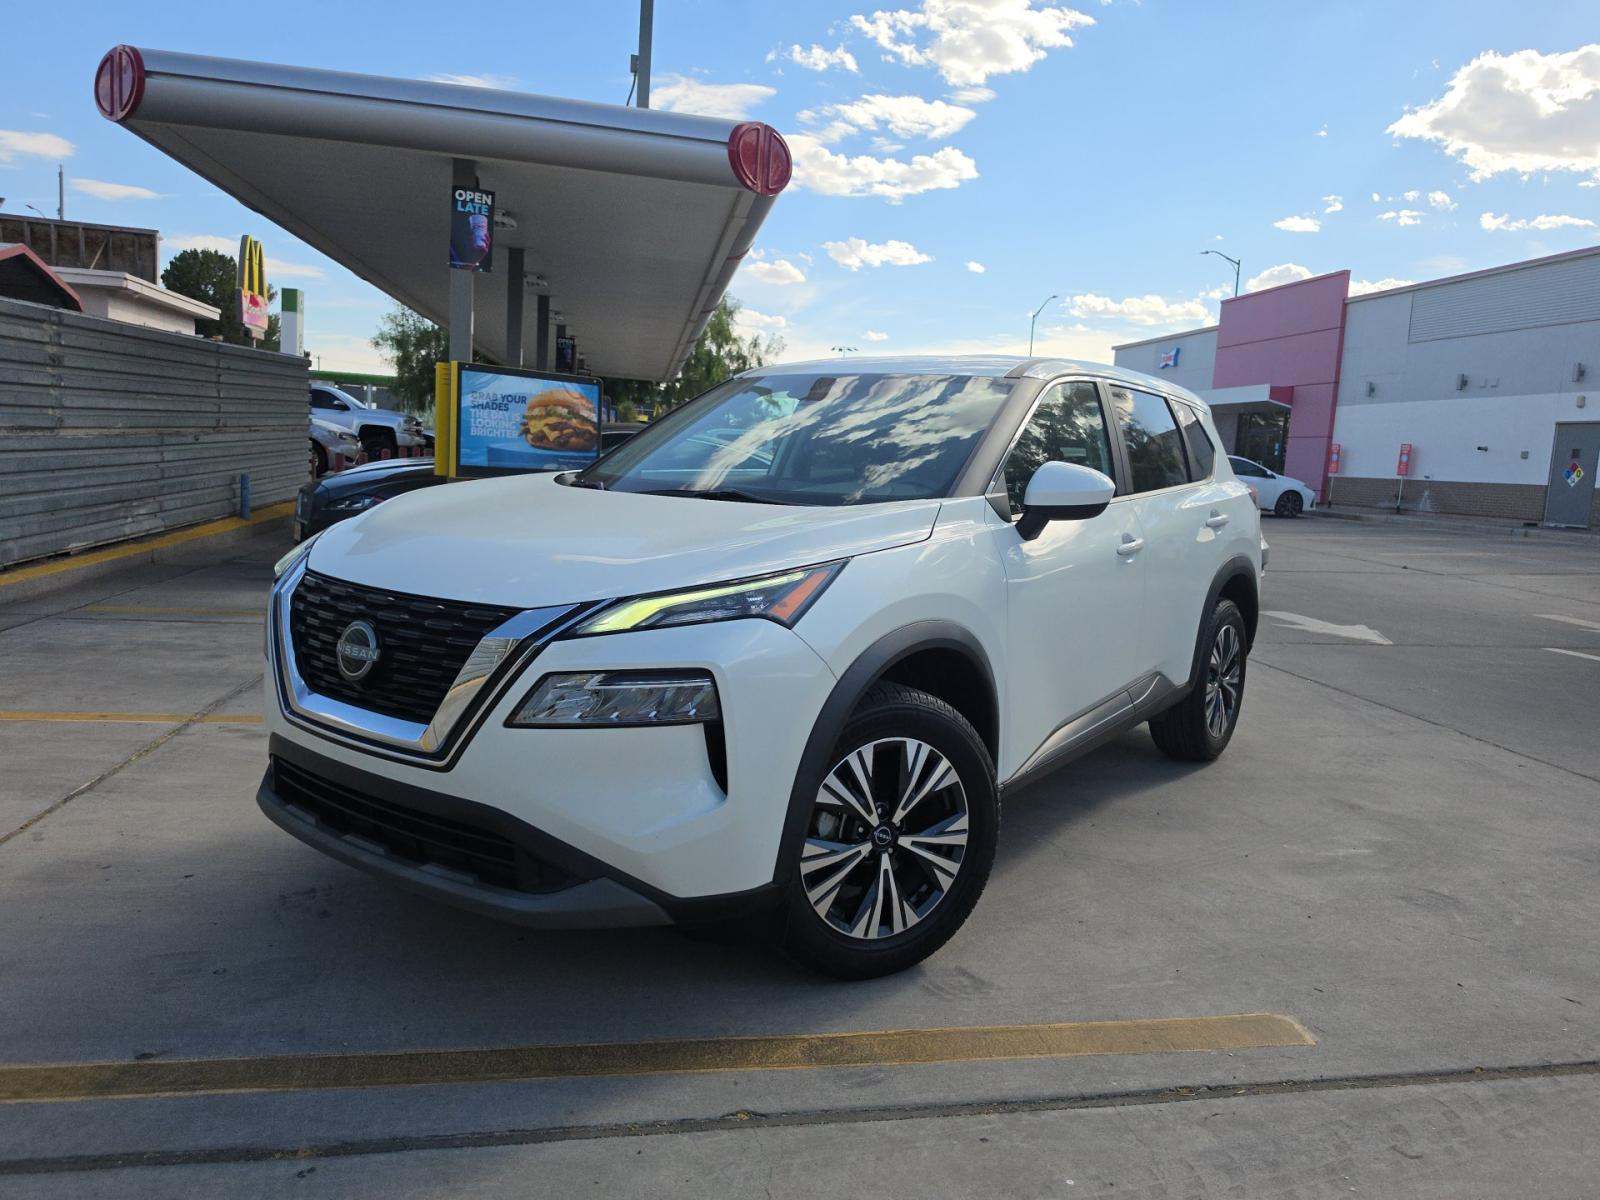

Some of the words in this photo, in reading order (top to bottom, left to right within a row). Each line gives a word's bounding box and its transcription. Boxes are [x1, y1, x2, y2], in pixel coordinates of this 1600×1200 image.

[455, 189, 492, 205] OPEN
[457, 201, 489, 216] LATE
[471, 400, 509, 412] SHADES
[500, 394, 527, 405] YOUR
[337, 640, 378, 660] NISSAN
